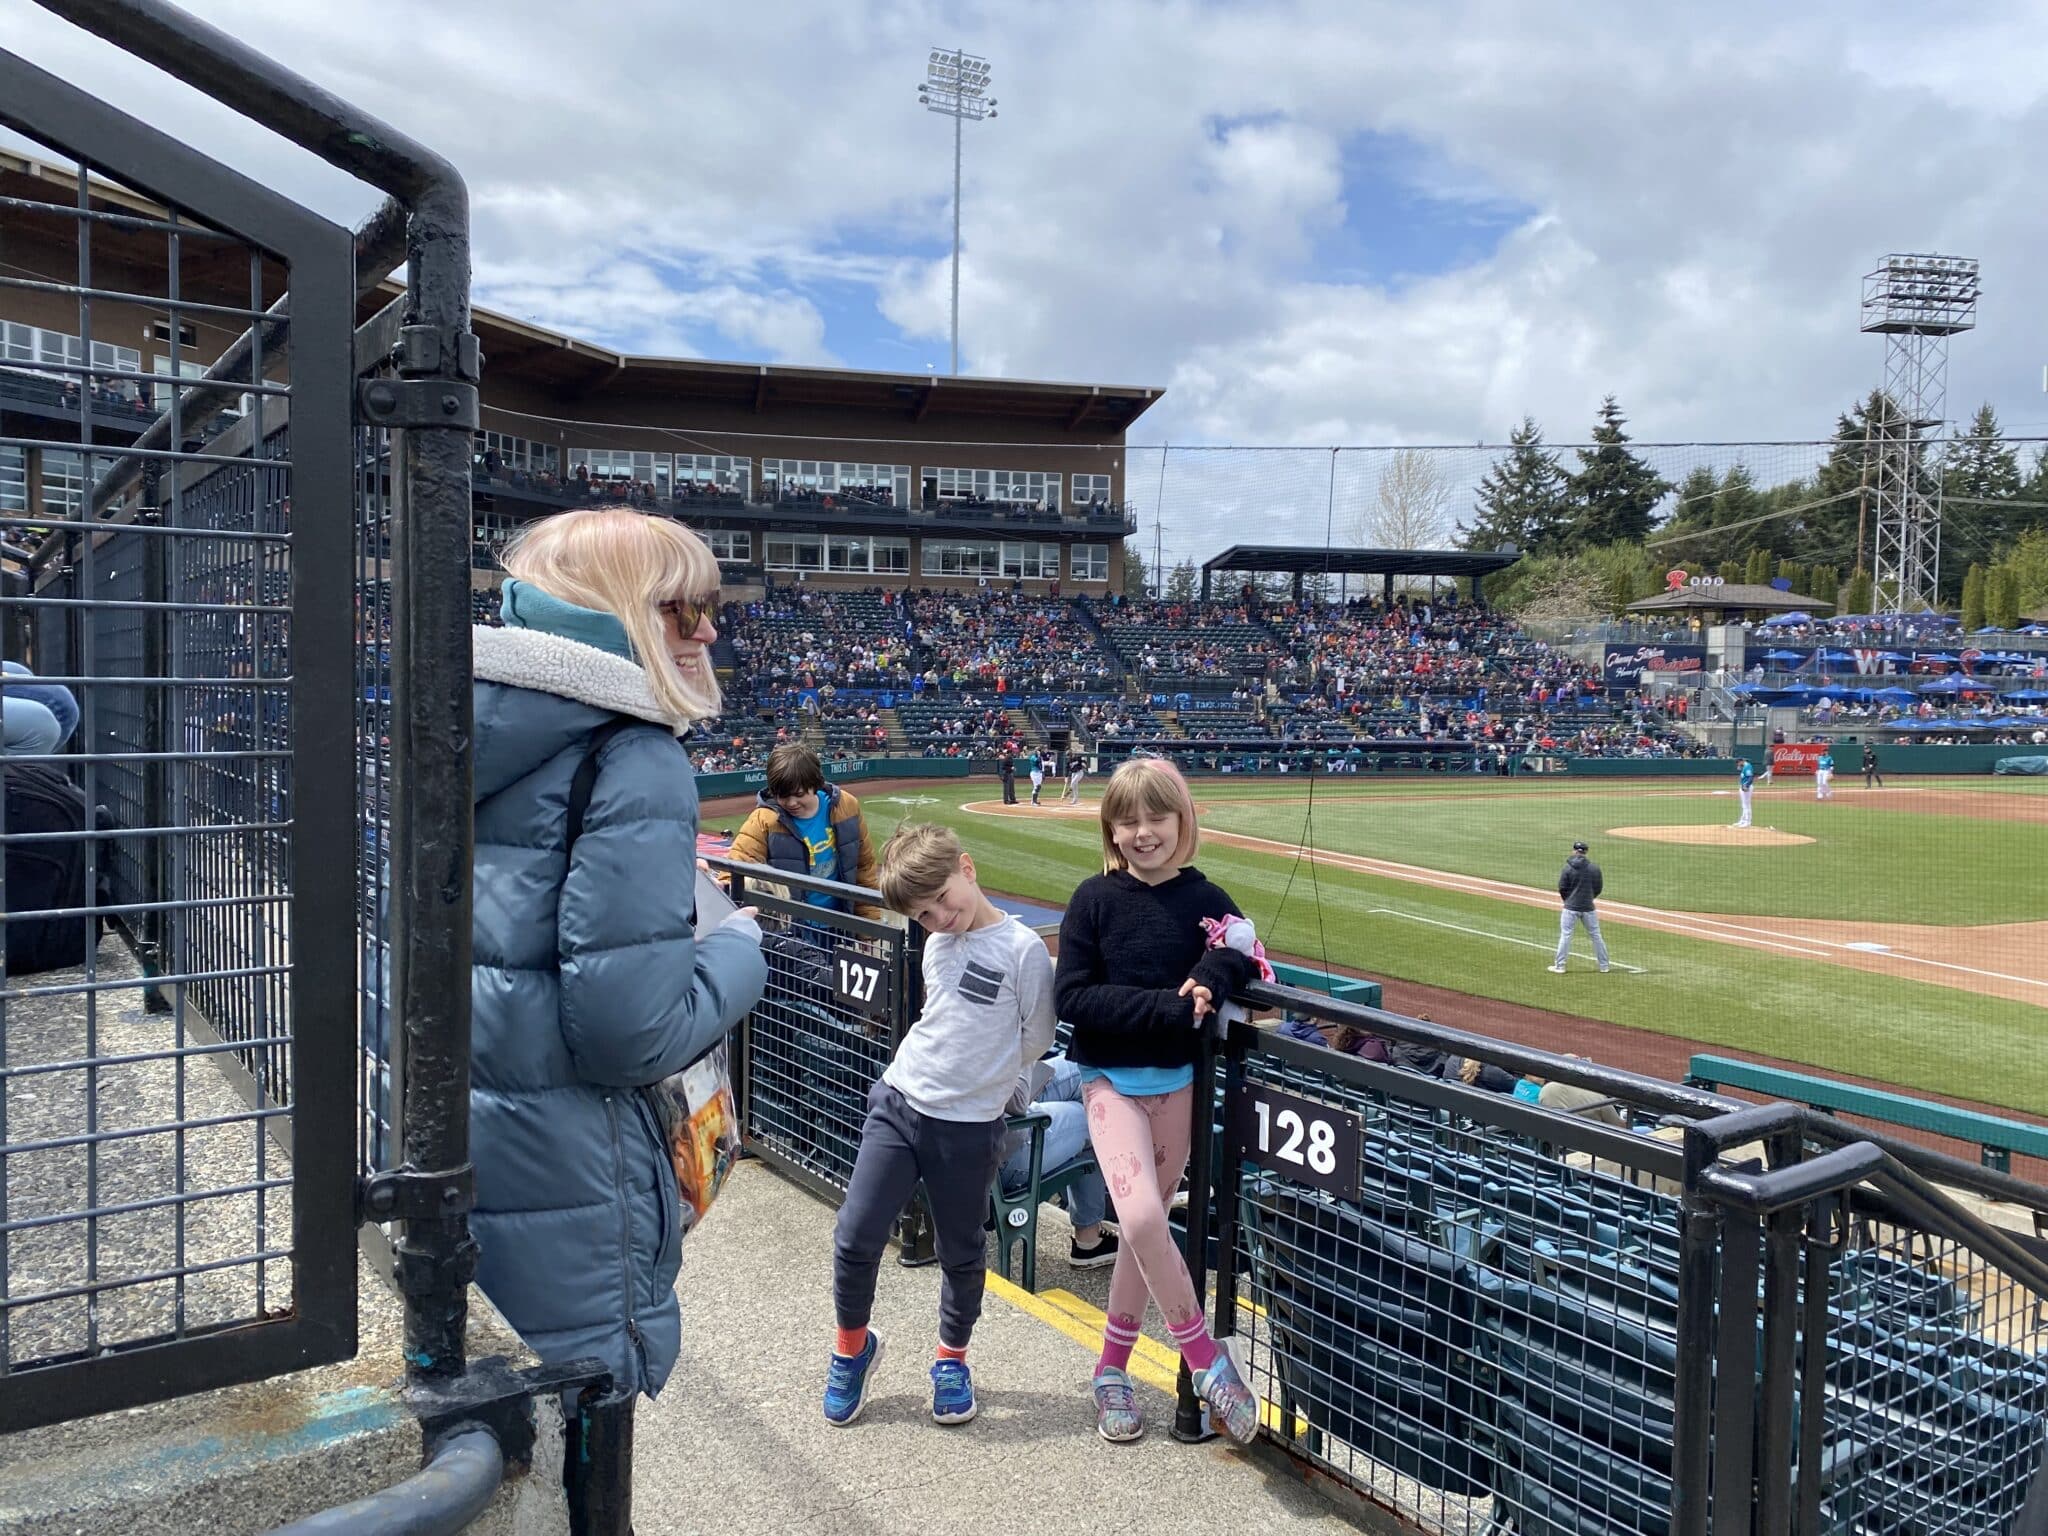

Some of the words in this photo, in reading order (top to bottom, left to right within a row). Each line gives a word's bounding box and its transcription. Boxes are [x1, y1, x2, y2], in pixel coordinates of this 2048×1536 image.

[1774, 747, 1805, 765] Bally
[839, 958, 880, 1003] 127
[1254, 1100, 1336, 1175] 128
[1012, 1212, 1025, 1223] 10
